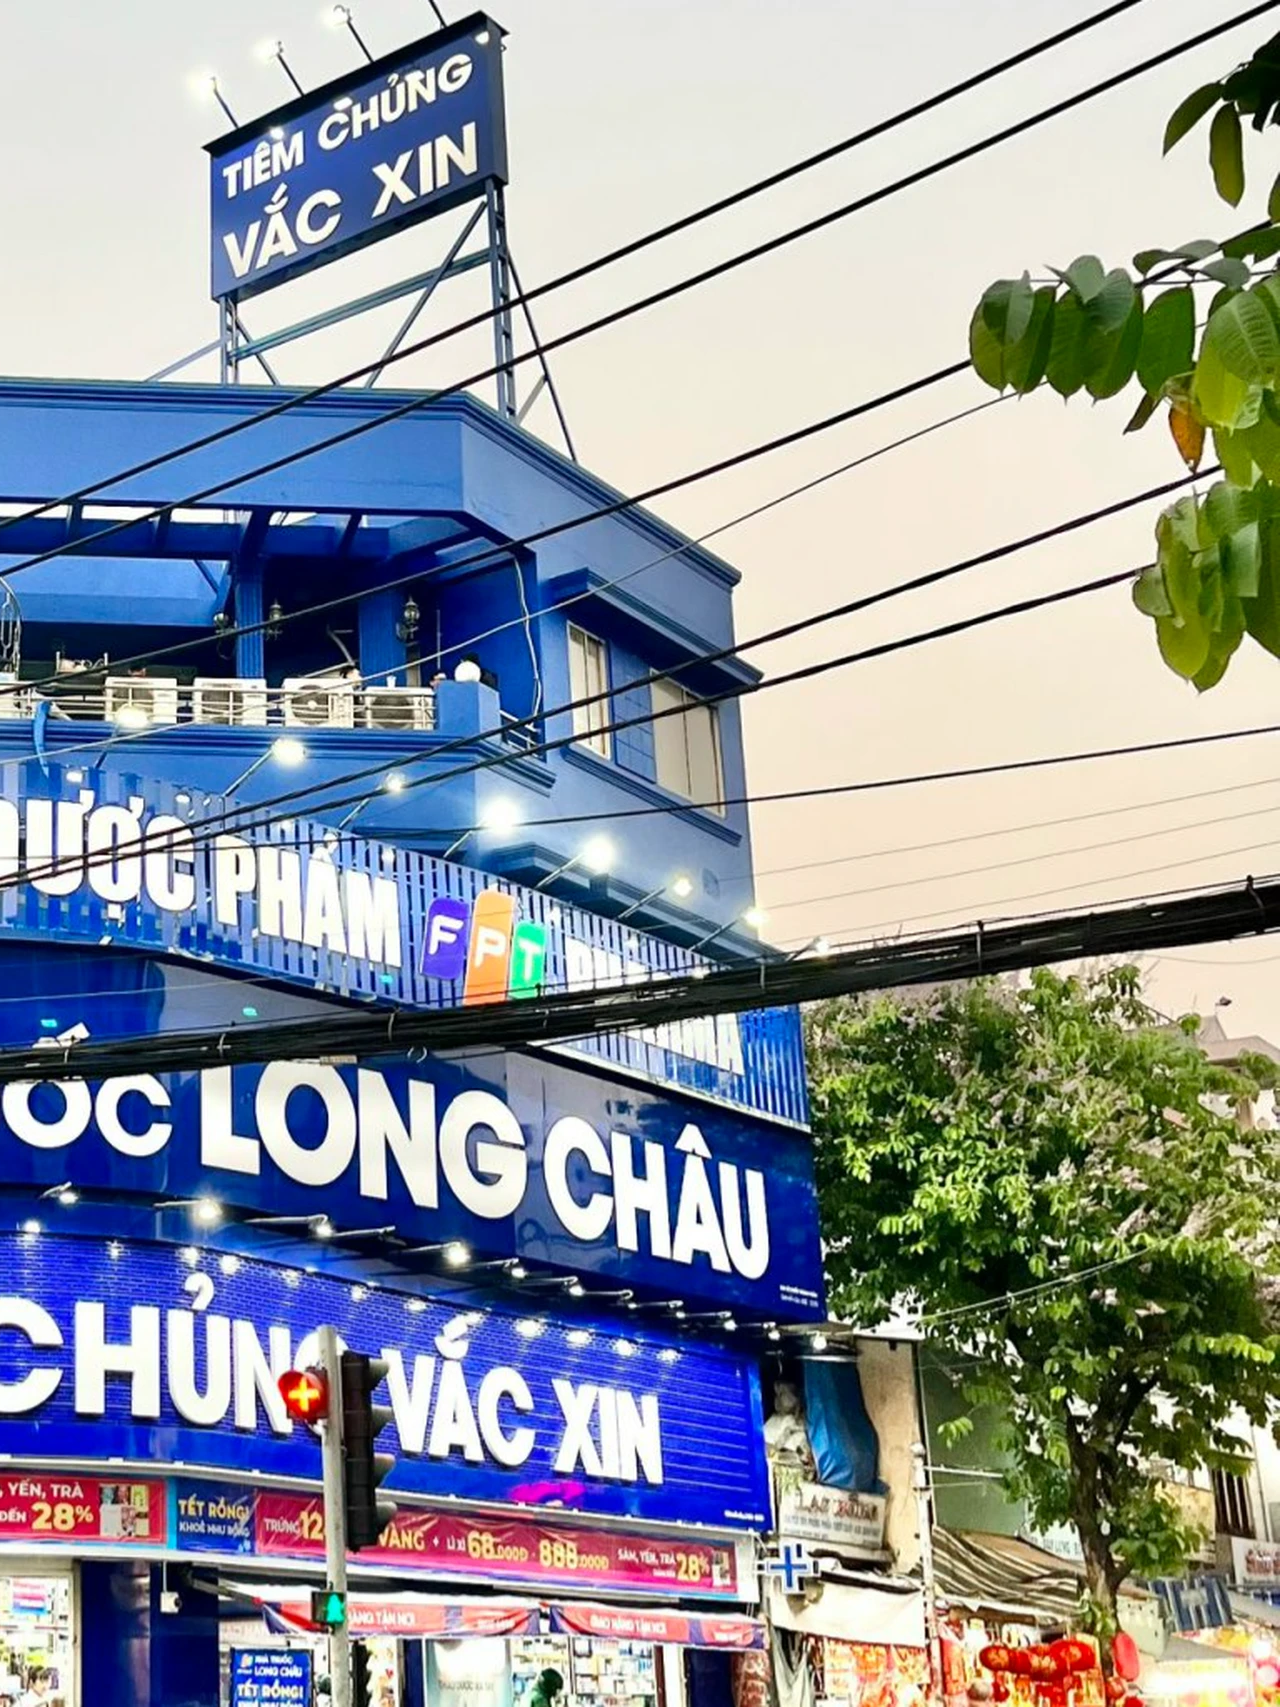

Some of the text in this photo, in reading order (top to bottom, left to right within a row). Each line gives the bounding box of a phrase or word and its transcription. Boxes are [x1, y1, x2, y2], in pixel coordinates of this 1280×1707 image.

[223, 53, 473, 199] TIÊM CHỦNG
[223, 122, 478, 278] VẮC XIN
[211, 830, 401, 968] PHẨM
[201, 1060, 527, 1219] LONG
[544, 1123, 770, 1280] CHÂU
[380, 1314, 537, 1468] VẮC
[551, 1378, 664, 1485] XIN
[8, 1478, 46, 1500] YẾN,
[51, 1480, 84, 1499] TRÀ
[31, 1501, 94, 1531] 28%
